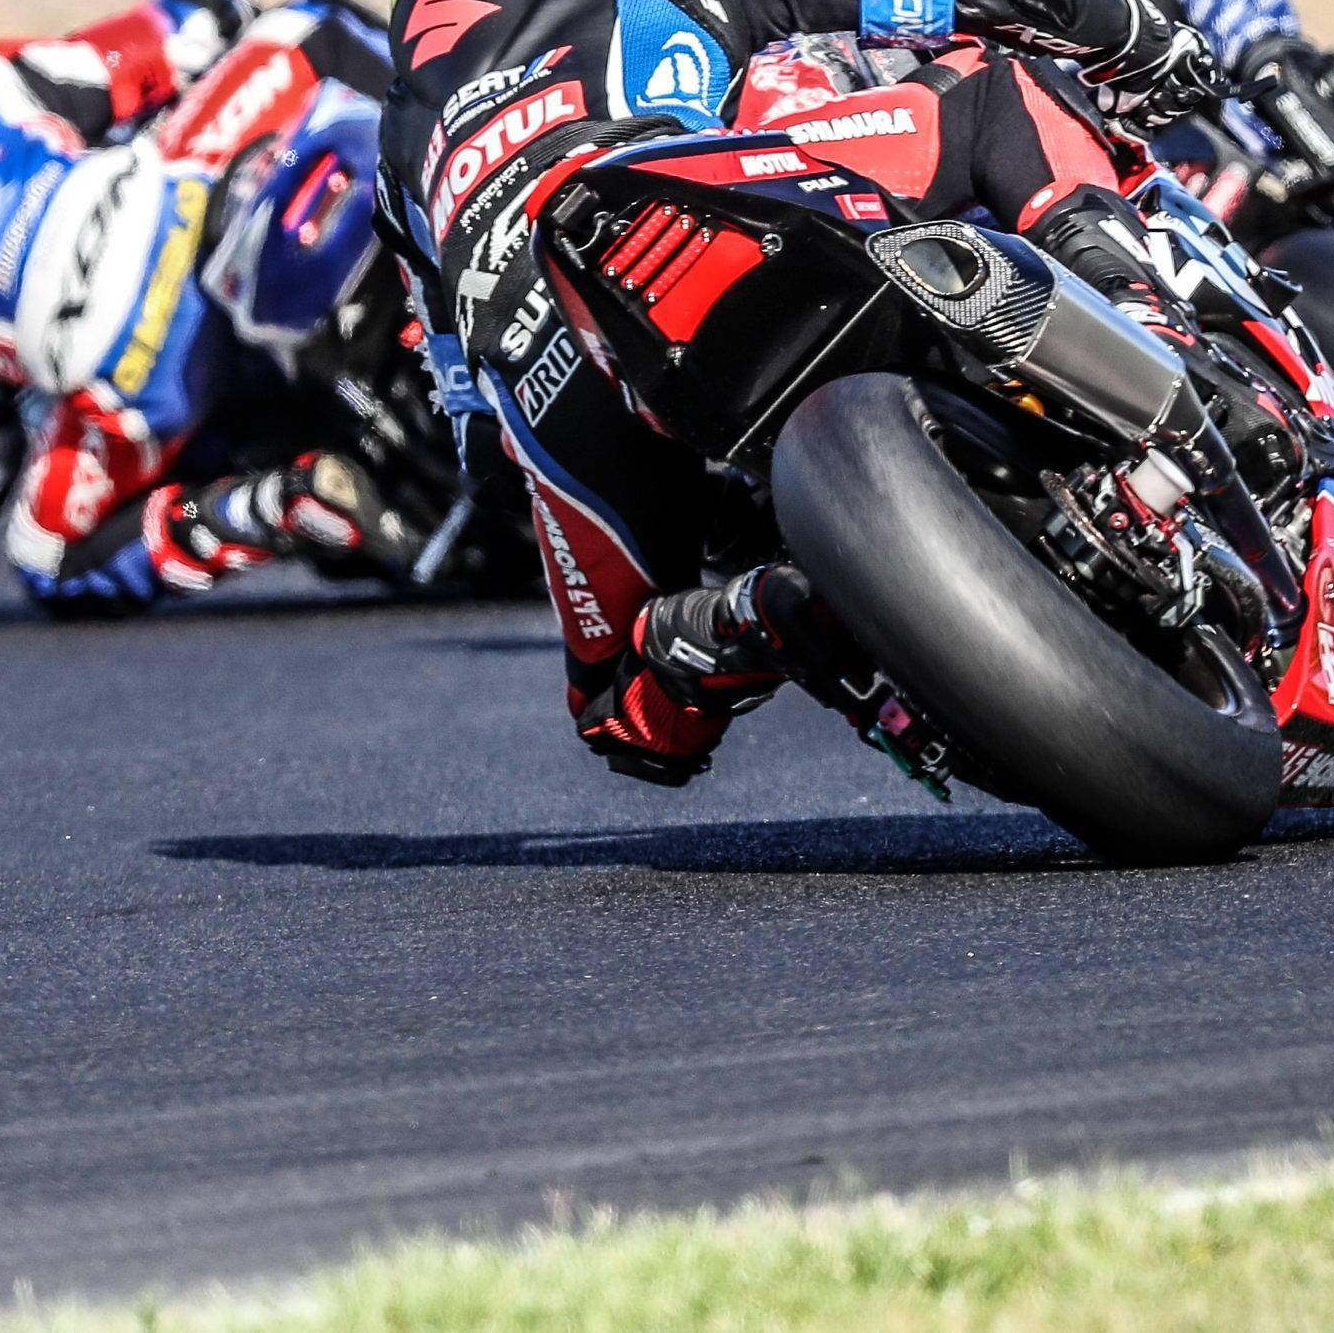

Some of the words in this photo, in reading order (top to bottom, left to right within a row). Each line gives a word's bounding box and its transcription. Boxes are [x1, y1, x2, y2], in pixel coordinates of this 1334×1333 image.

[432, 89, 575, 248] MOTUL
[739, 151, 808, 178] MOTUL
[499, 277, 548, 363] SU
